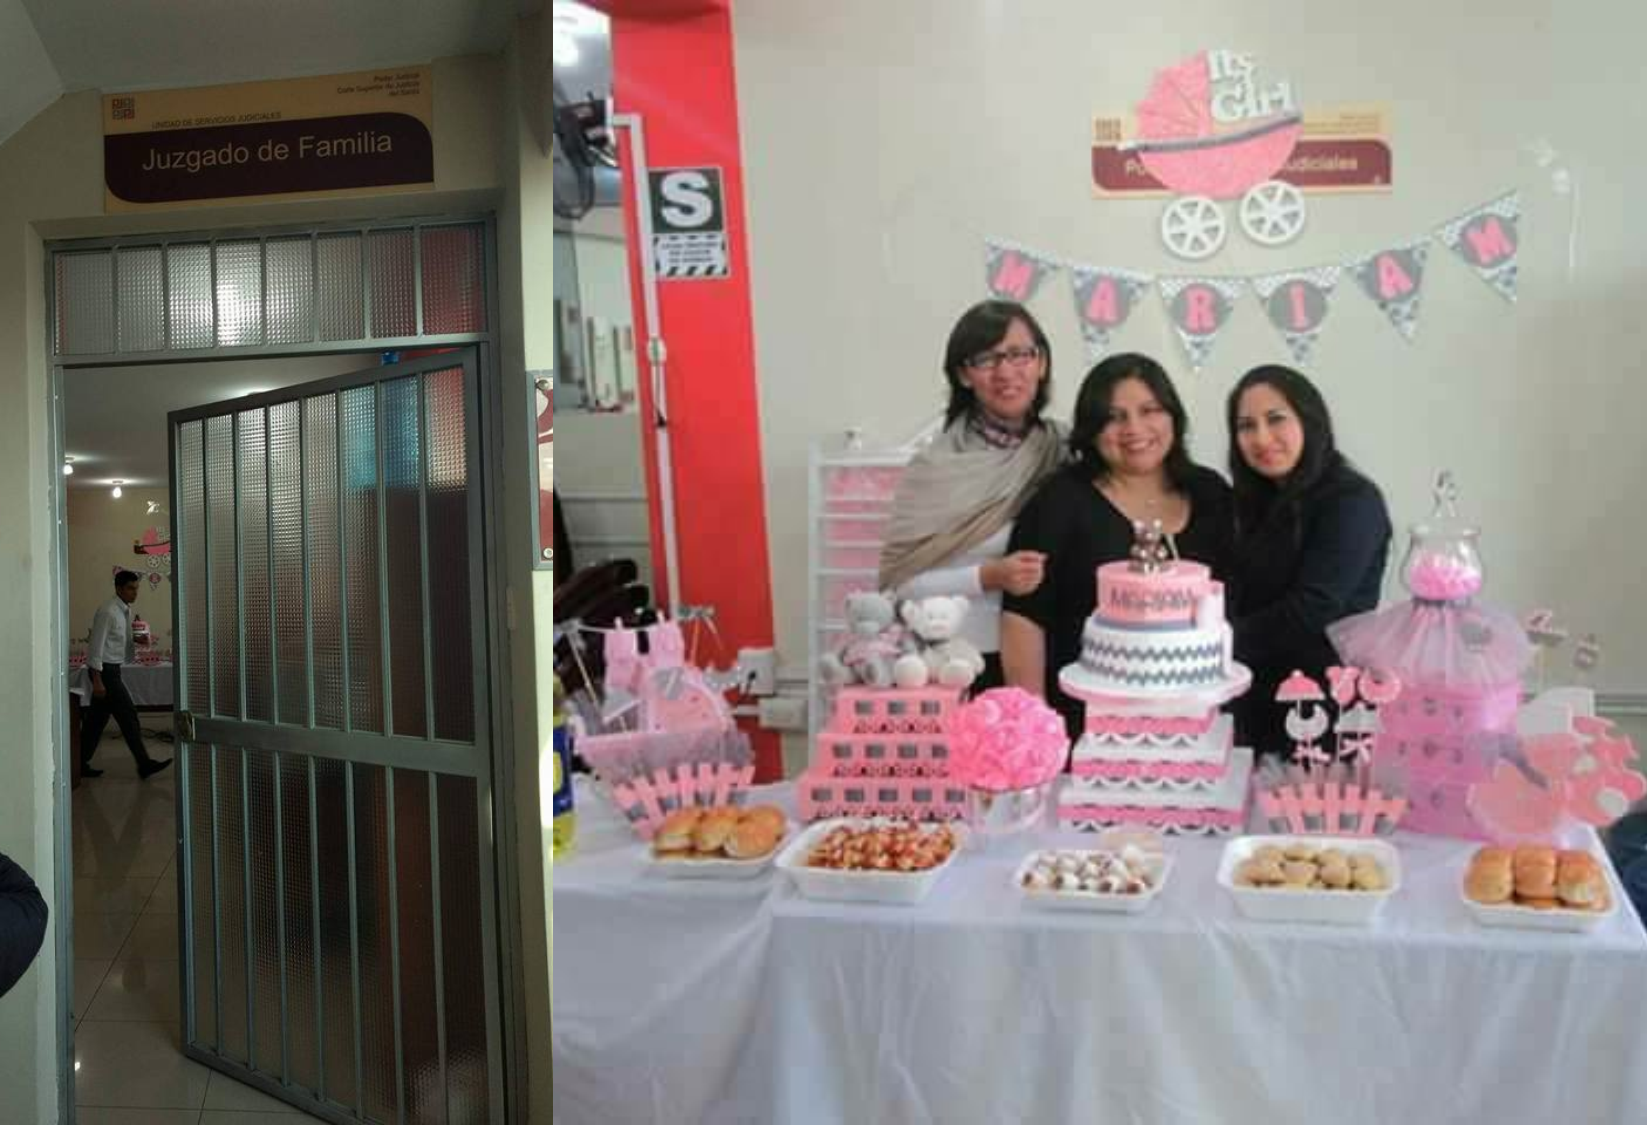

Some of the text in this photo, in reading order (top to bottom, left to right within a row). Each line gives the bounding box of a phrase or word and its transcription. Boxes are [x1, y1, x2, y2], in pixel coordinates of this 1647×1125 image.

[196, 114, 236, 125] SERVICIOS
[238, 111, 281, 123] JUDICIALES
[142, 131, 393, 173] Juzgado de Familia
[661, 171, 713, 228] S
